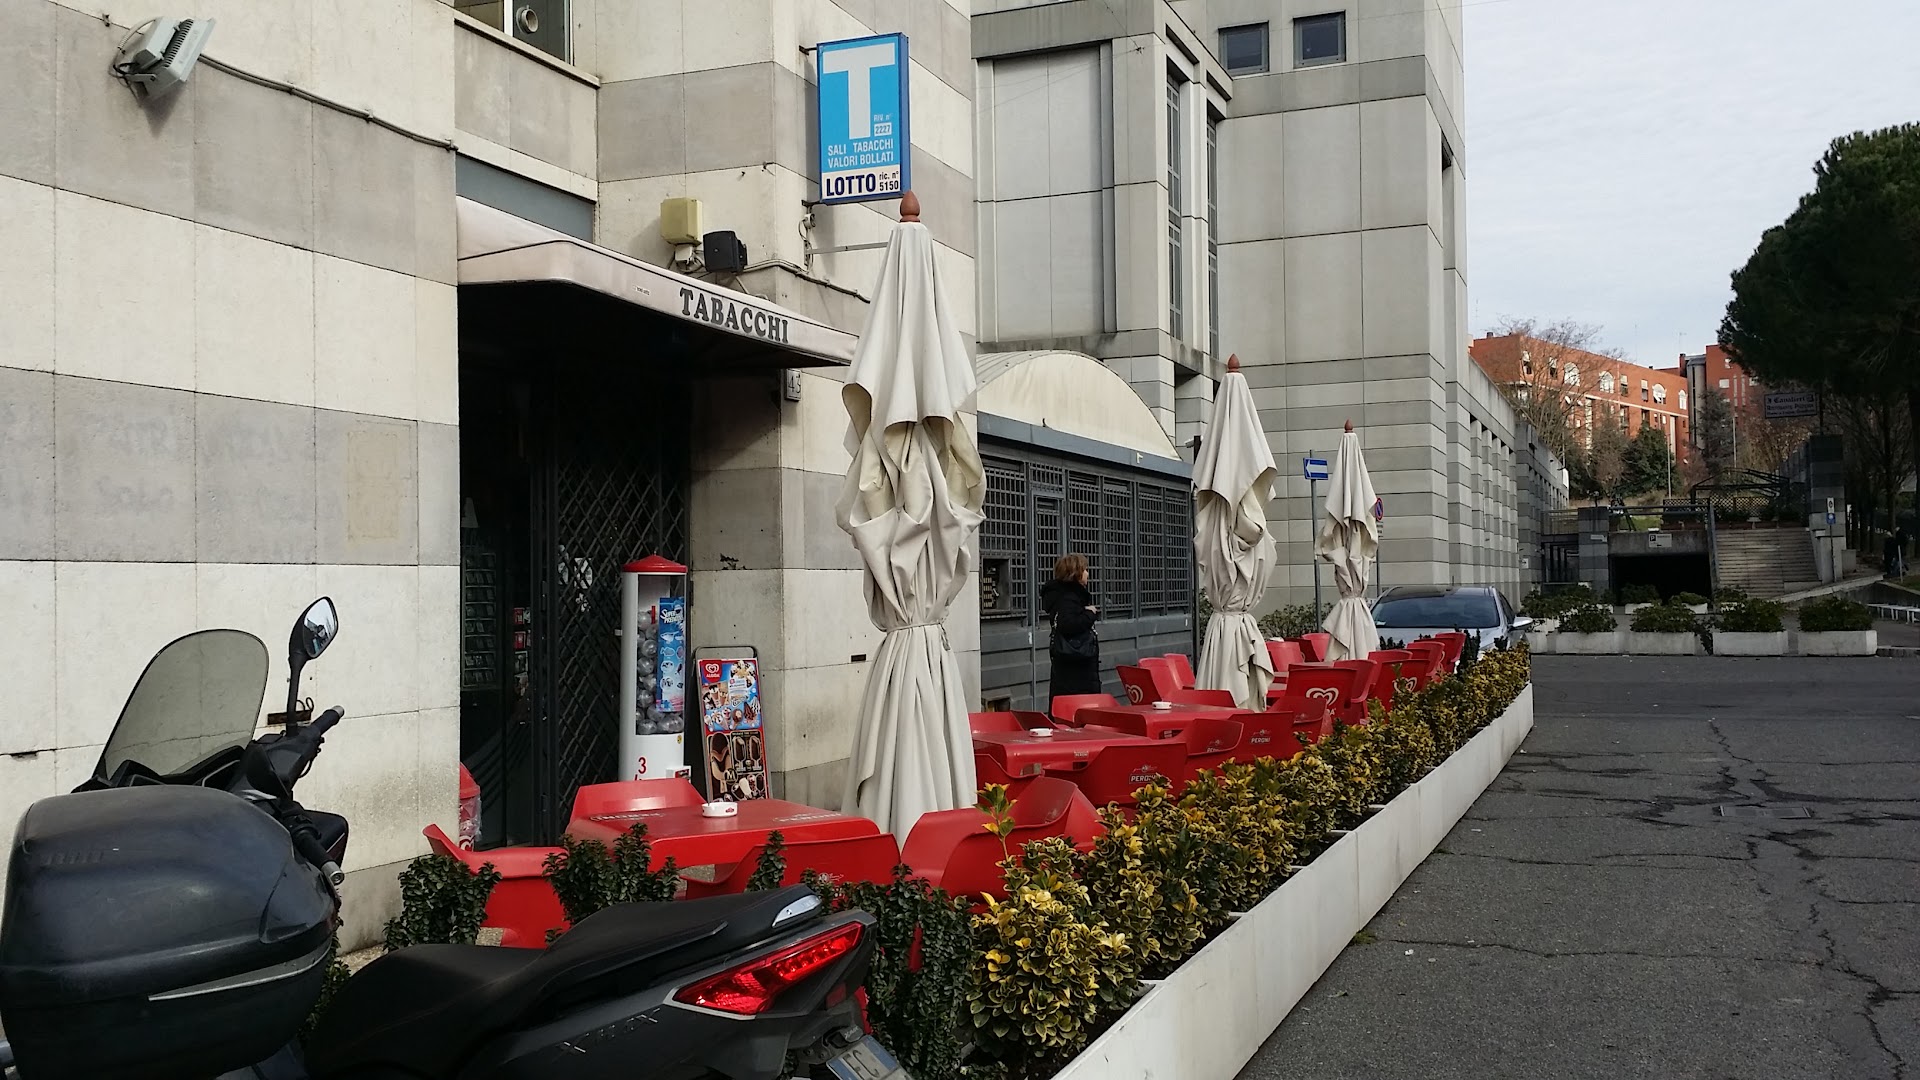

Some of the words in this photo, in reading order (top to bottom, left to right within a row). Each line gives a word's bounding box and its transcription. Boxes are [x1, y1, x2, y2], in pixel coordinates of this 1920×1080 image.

[823, 43, 895, 139] T
[875, 124, 891, 135] 2227
[828, 143, 846, 156] SALI
[853, 138, 893, 152] TABACCHI
[828, 154, 858, 168] VALORI
[860, 151, 893, 165] BOLLATI
[826, 173, 876, 196] LOTTO
[879, 180, 899, 192] 5150
[679, 286, 789, 344] TABACCHI
[788, 373, 801, 394] 43
[638, 756, 647, 774] 3
